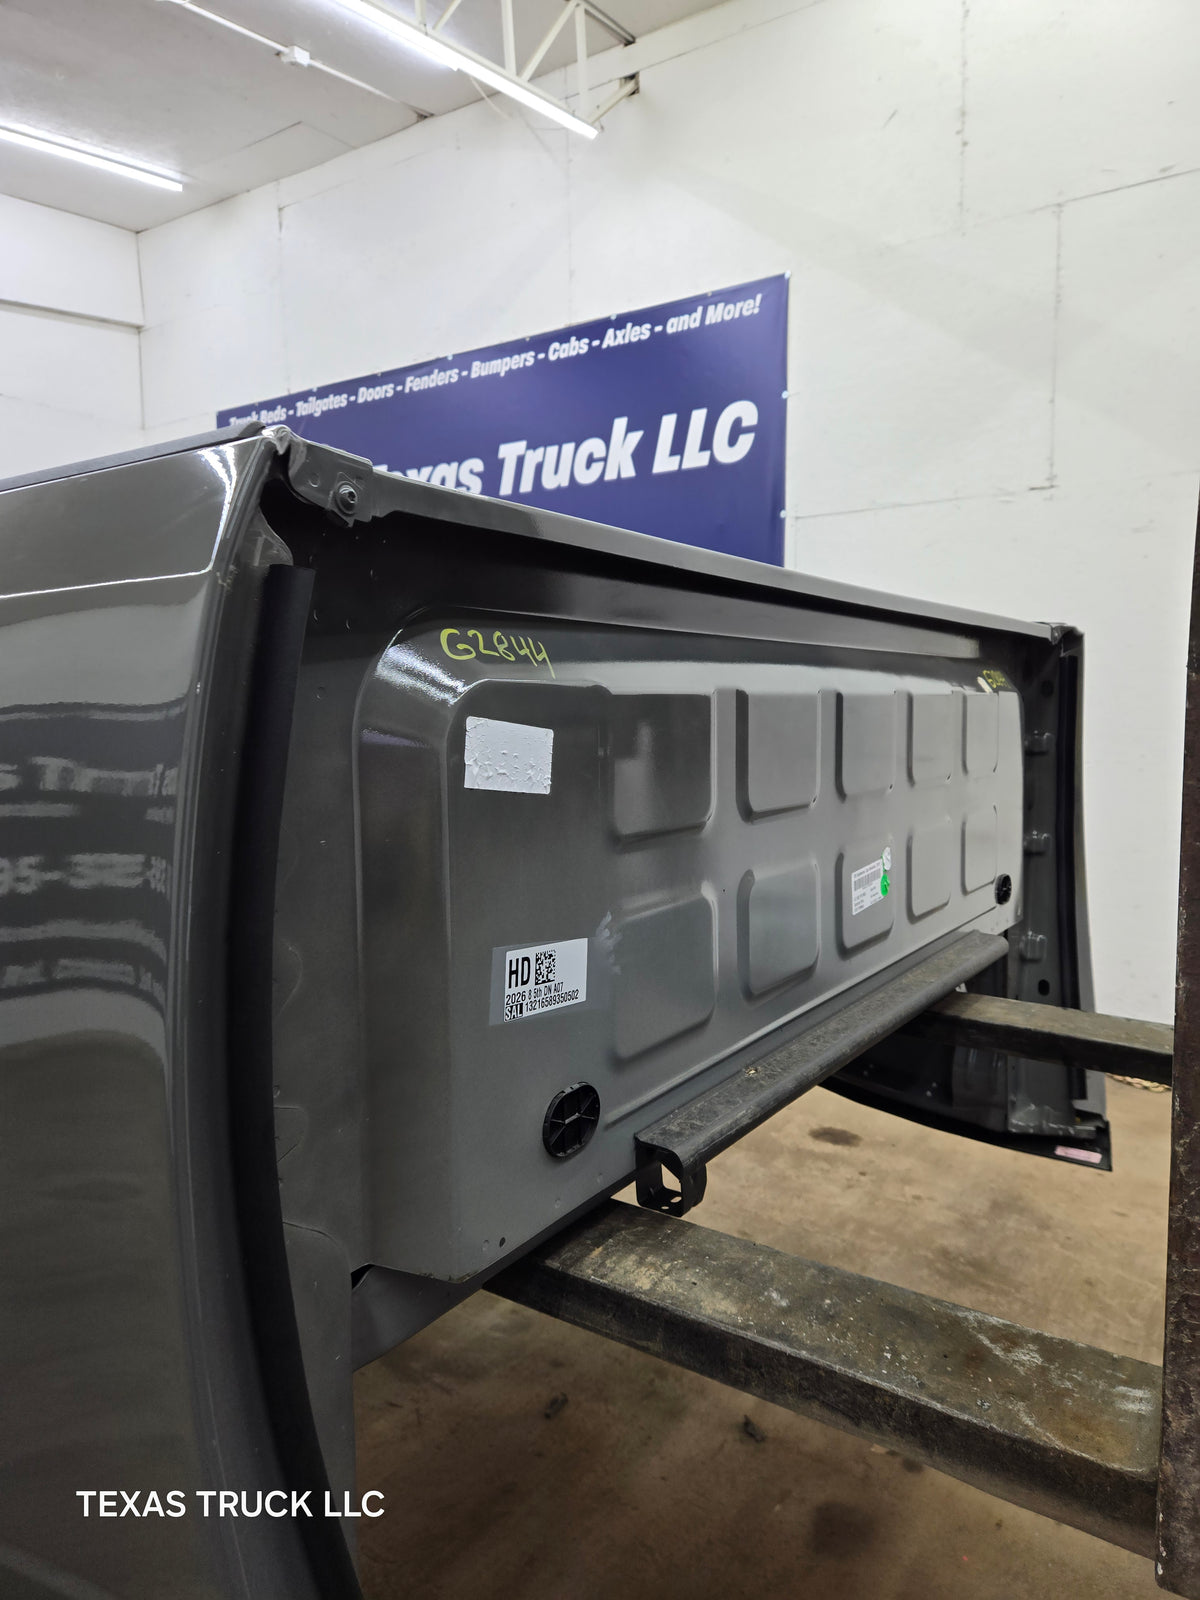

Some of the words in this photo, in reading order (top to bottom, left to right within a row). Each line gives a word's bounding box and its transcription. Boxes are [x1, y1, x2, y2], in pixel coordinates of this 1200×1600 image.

[260, 404, 287, 424] Beds
[296, 394, 348, 418] Tailgates
[357, 384, 394, 404] Doors
[404, 368, 459, 393] Fenders
[470, 351, 535, 378] Bumpers
[548, 336, 589, 361] Cabs
[602, 322, 651, 349] Axles
[666, 306, 703, 334] and
[705, 294, 762, 325] More!
[498, 416, 644, 496] Truck
[652, 400, 758, 474] LLC
[440, 628, 556, 679] G2844
[508, 957, 531, 989] HD
[505, 1003, 524, 1021] SAL
[506, 991, 526, 1005] 2026
